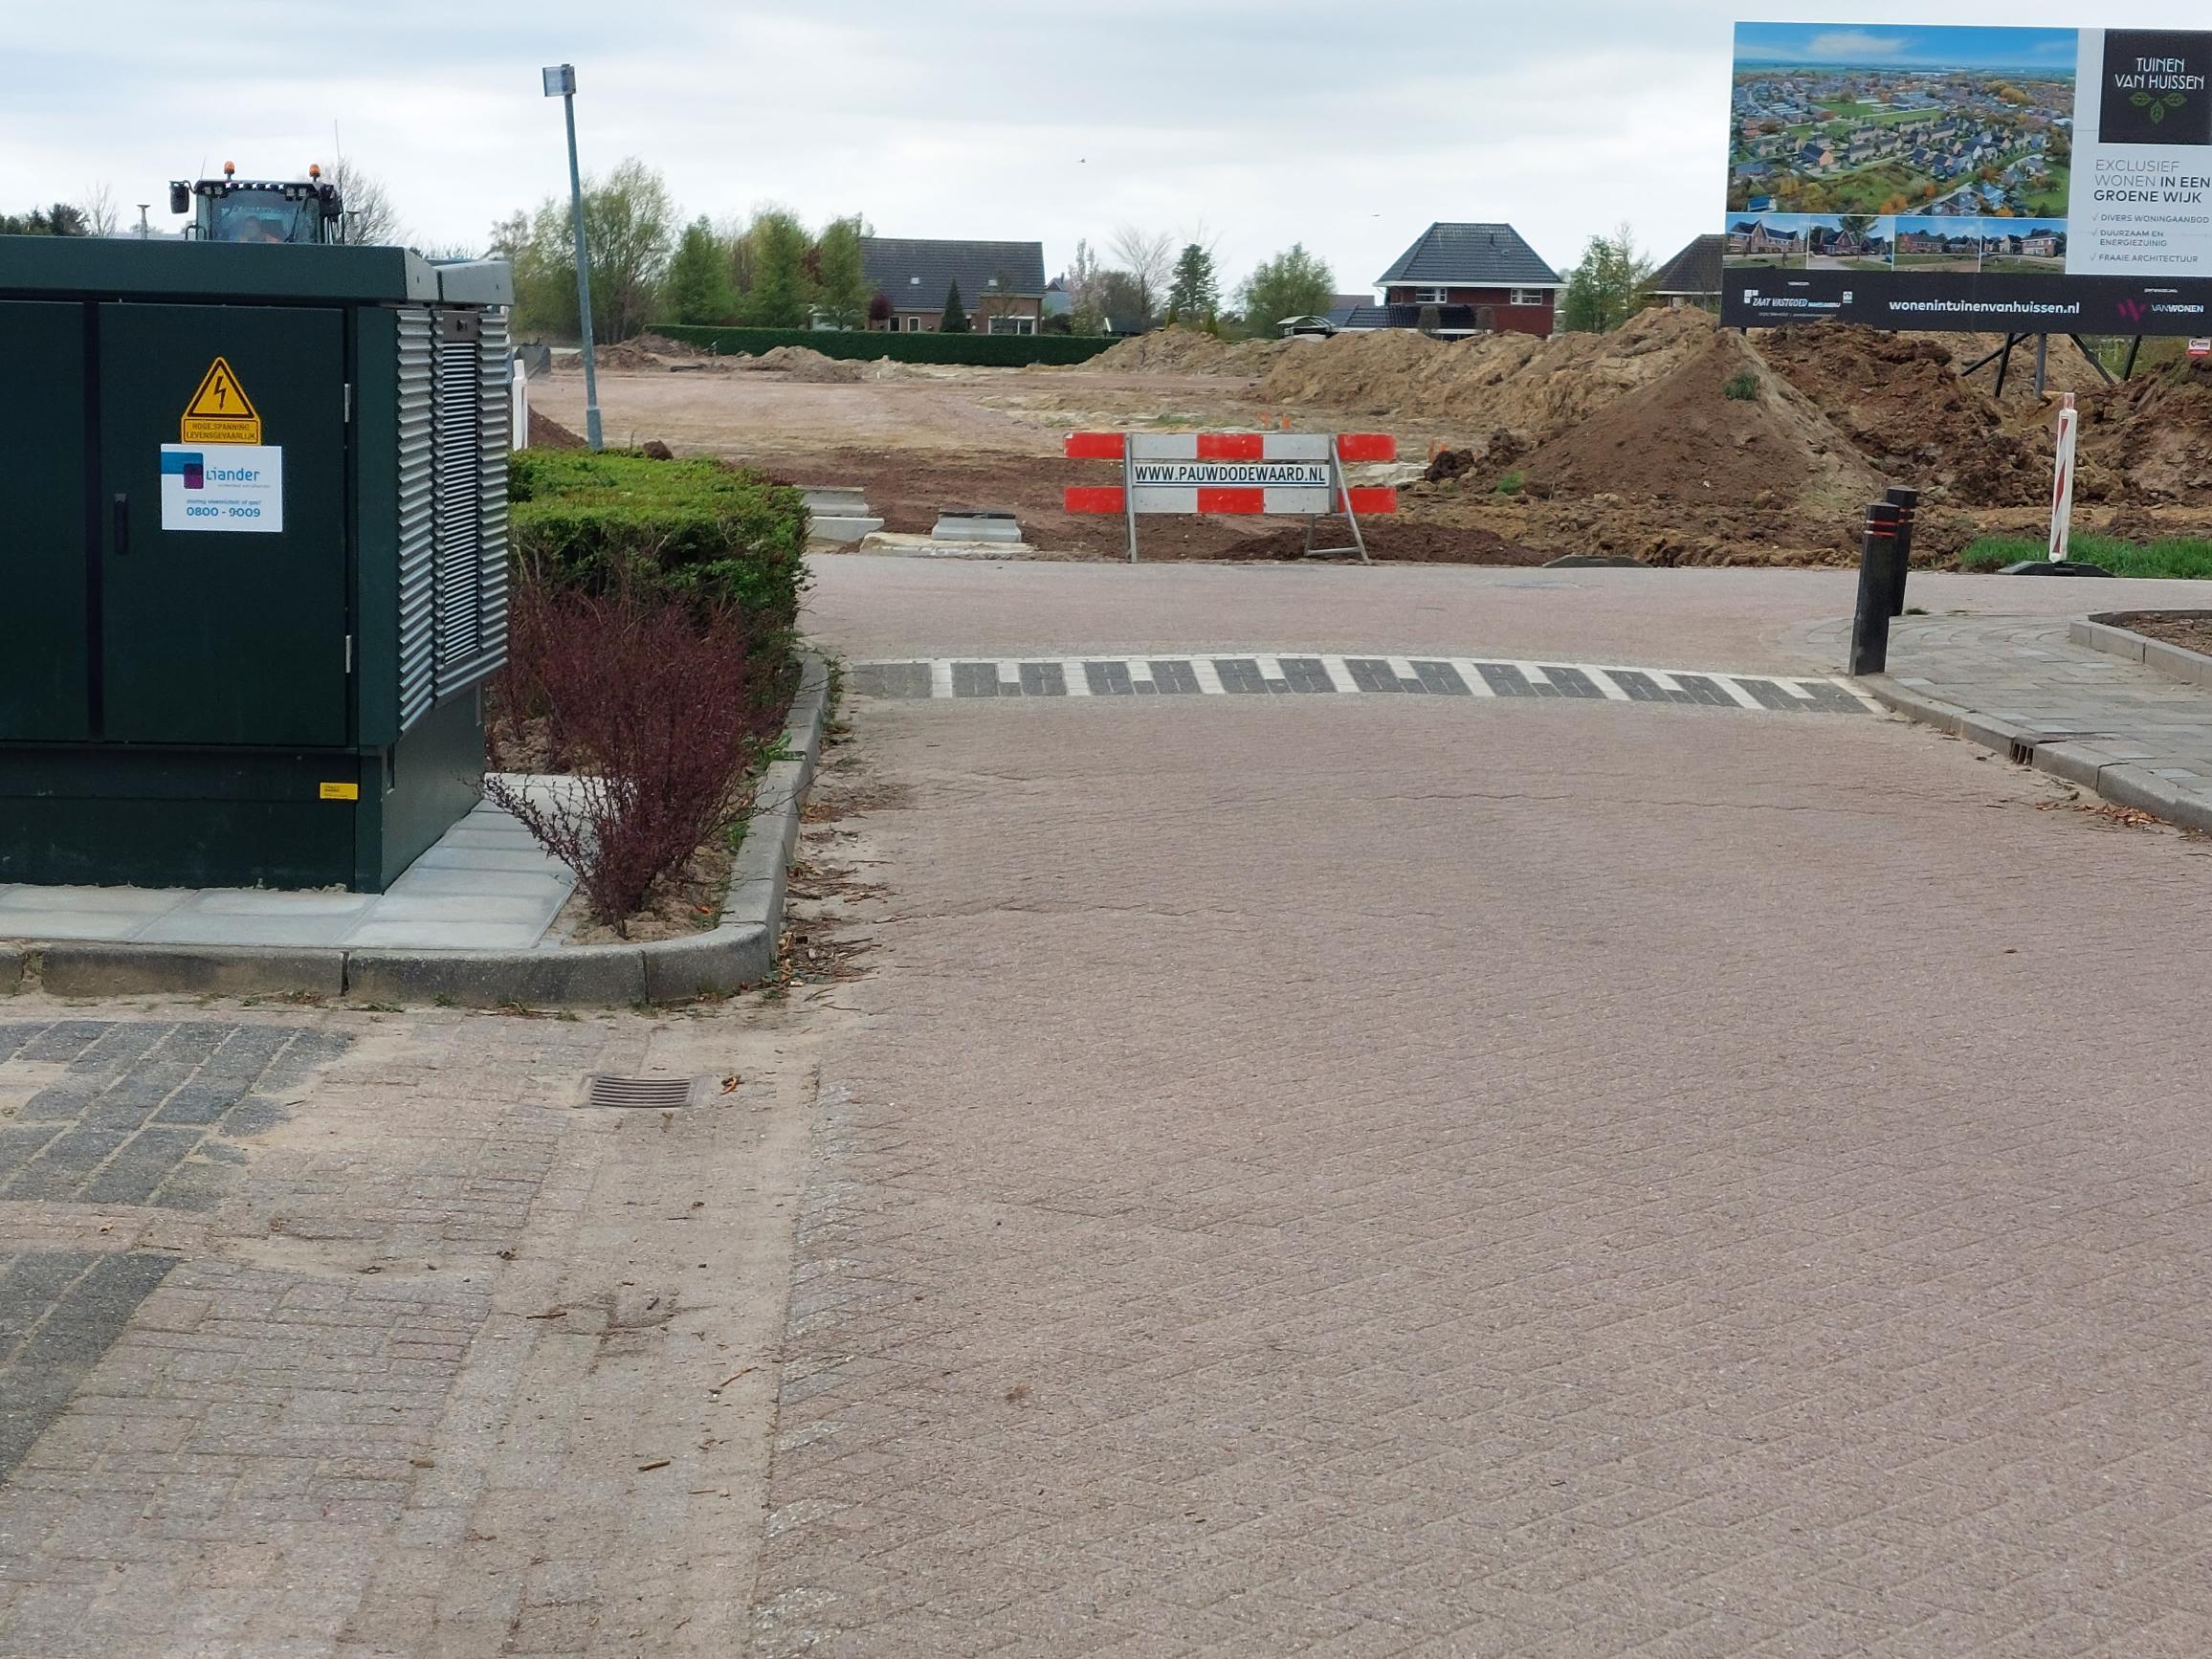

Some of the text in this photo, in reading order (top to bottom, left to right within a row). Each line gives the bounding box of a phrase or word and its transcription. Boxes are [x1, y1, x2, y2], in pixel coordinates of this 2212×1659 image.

[2135, 57, 2185, 74] TUINEN
[2114, 74, 2205, 90] VAN HUISSEN
[2095, 159, 2180, 172] EXCLUSIEF
[2094, 174, 2211, 188] WONEN IN EEN
[2093, 189, 2202, 204] GROENE WIJK
[2100, 213, 2210, 224] DIVERS WONINGAANBOD
[2099, 238, 2167, 247] ENERGIEZUINIG
[2098, 254, 2199, 263] FRAAIE ARCHITECTUUR
[1889, 299, 2080, 315] wonenintuinenvanhuissen.nl
[206, 467, 260, 481] Liander
[1135, 466, 1326, 481] WWW.PAUWDODEWAARD.NL
[187, 507, 219, 517] 0800
[229, 507, 261, 518] 9009
